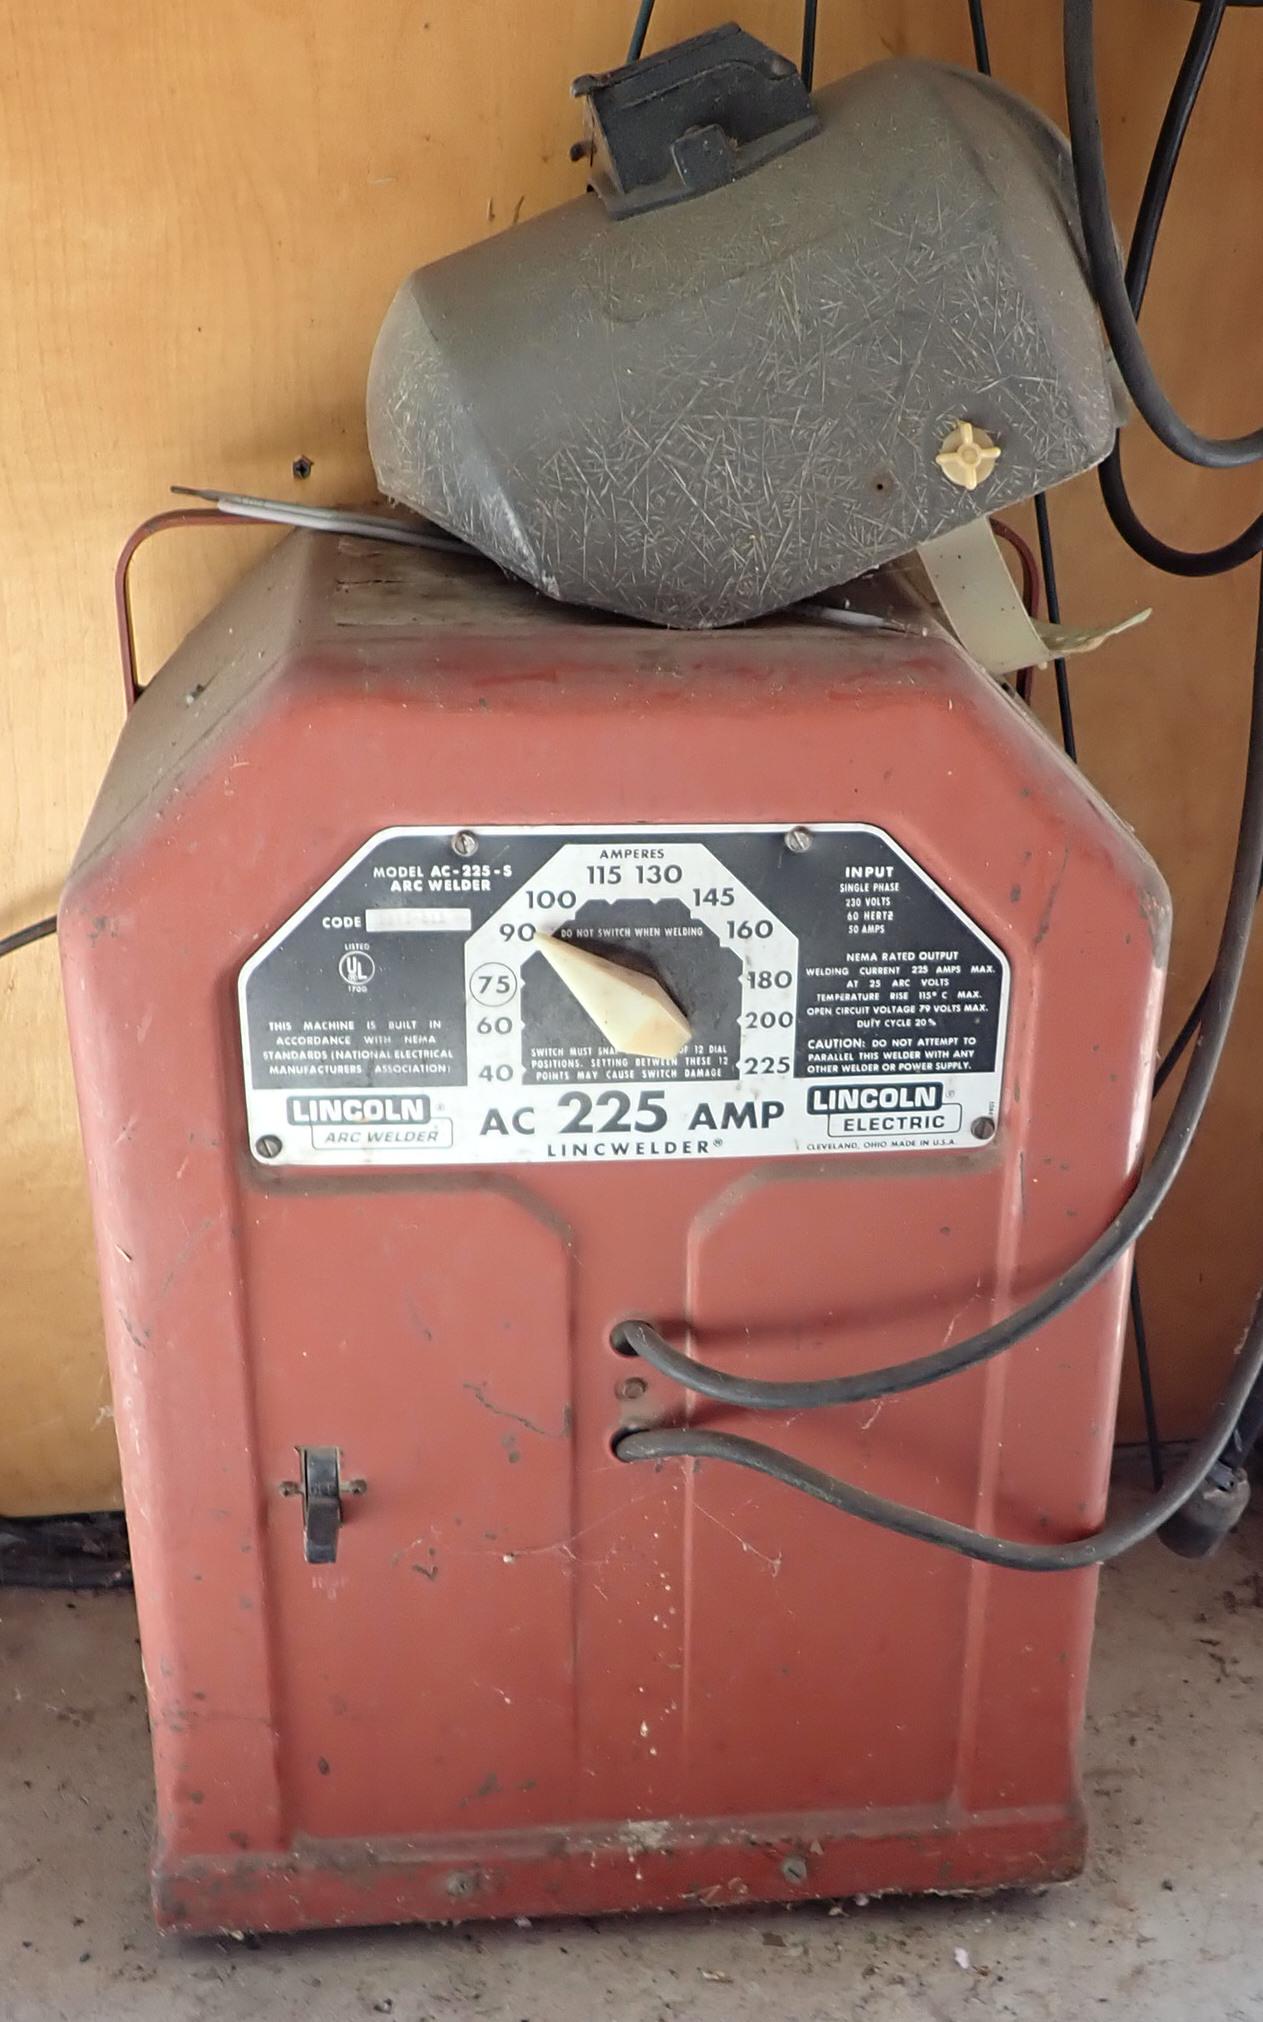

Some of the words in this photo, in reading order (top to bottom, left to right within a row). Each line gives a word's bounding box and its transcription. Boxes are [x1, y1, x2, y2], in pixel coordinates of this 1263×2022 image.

[600, 849, 664, 860] AMPERES
[373, 866, 424, 878] MODEL
[430, 864, 512, 877] AC-225-S
[586, 865, 622, 885] 115
[636, 864, 682, 884] 130
[846, 866, 894, 878] INPUT
[390, 880, 422, 892] ARC
[428, 879, 491, 891] WELDER
[840, 883, 869, 892] SINGLE
[873, 882, 900, 892] PHASE
[526, 890, 577, 909] 100
[692, 887, 734, 906] 145
[846, 898, 861, 908] 230
[865, 897, 890, 906] VOLTS
[847, 912, 858, 920] 60
[864, 911, 894, 920] HERTZ
[322, 917, 361, 928] CODE
[848, 925, 858, 934] 50
[862, 924, 885, 934] AMPS
[500, 923, 536, 942] 90
[561, 929, 574, 938] DO
[576, 929, 594, 938] NOT
[598, 928, 631, 938] SWITCH
[634, 928, 661, 937] WHEN
[664, 926, 704, 937] WELDING
[726, 920, 774, 939] 160
[344, 942, 370, 950] LISTED
[846, 952, 878, 962] NEMA
[882, 952, 915, 962] RATED
[918, 951, 958, 961] OUTPUT
[346, 956, 368, 980] UL
[806, 967, 849, 976] WELDING
[860, 966, 900, 976] CURRENT
[912, 966, 928, 974] 225
[936, 966, 961, 974] AMPS
[971, 965, 996, 974] MAX.
[478, 975, 511, 995] 75
[748, 970, 792, 990] 180
[846, 980, 858, 988] AT
[869, 980, 881, 988] 25
[892, 979, 910, 988] ARC
[921, 978, 950, 987] VOLTS
[816, 992, 880, 1002] TEMPERATURE
[890, 992, 908, 1000] RISE
[941, 991, 948, 1000] C
[958, 990, 982, 999] MAX.
[806, 1007, 832, 1016] OPEN
[836, 1006, 869, 1015] CIRCUIT
[873, 1005, 915, 1014] VOLTAGE
[918, 1004, 932, 1013] 79
[934, 1004, 961, 1013] VOLTS
[964, 1004, 988, 1012] MAX.
[268, 1022, 292, 1031] THIS
[304, 1021, 354, 1030] MACHINE
[367, 1021, 376, 1030] IS
[388, 1020, 417, 1030] BUILT
[430, 1020, 441, 1029] IN
[476, 1016, 513, 1034] 60
[745, 1011, 794, 1030] 200
[857, 1018, 880, 1028] DUTY
[884, 1018, 912, 1028] CYCLE
[276, 1036, 350, 1046] ACCORDANCE
[364, 1036, 392, 1044] WITH
[404, 1035, 436, 1044] NEMA
[808, 1039, 866, 1050] CAUTION:
[872, 1038, 887, 1047] DO
[892, 1038, 912, 1047] NOT
[917, 1037, 958, 1046] ATTEMPT
[964, 1036, 976, 1046] TO
[264, 1050, 327, 1060] STANDARDS
[330, 1050, 392, 1060] (NATIONAL
[394, 1049, 454, 1059] ELECTRICAL
[531, 1048, 564, 1058] SWITCH
[570, 1047, 592, 1056] MUST
[694, 1045, 704, 1054] 12
[708, 1044, 727, 1054] DIAL
[808, 1052, 854, 1062] PARALLEL
[859, 1052, 878, 1060] THIS
[882, 1051, 921, 1060] WELDER
[925, 1050, 950, 1059] WITH
[953, 1050, 974, 1058] ANY
[270, 1064, 362, 1074] MANUFACTURERS
[531, 1060, 584, 1069] POSITIONS.
[590, 1058, 628, 1068] SETTING
[635, 1057, 678, 1067] BETWEEN
[686, 1057, 711, 1066] THESE
[718, 1057, 729, 1066] 12
[743, 1056, 791, 1076] 225
[807, 1064, 838, 1074] OTHER
[842, 1063, 879, 1072] WELDER
[882, 1062, 896, 1072] OR
[898, 1062, 933, 1071] POWER
[936, 1061, 972, 1070] SUPPLY.
[478, 1064, 514, 1083] 40
[536, 1071, 570, 1081] POINTS
[576, 1070, 598, 1080] MAY
[606, 1070, 635, 1080] CAUSE
[642, 1069, 676, 1078] SWITCH
[684, 1068, 722, 1078] DAMAGE
[813, 1086, 936, 1110] LINCOLN
[292, 1098, 424, 1122] LINCOLN
[480, 1106, 536, 1136] AC
[557, 1090, 668, 1134] 225
[688, 1099, 785, 1130] AMP
[844, 1115, 945, 1132] ELECTRIC
[324, 1131, 361, 1144] ARC
[367, 1130, 439, 1143] WELDER
[806, 1140, 861, 1151] CLEVELAND,
[864, 1140, 887, 1148] OHIO
[892, 1140, 916, 1148] MADE
